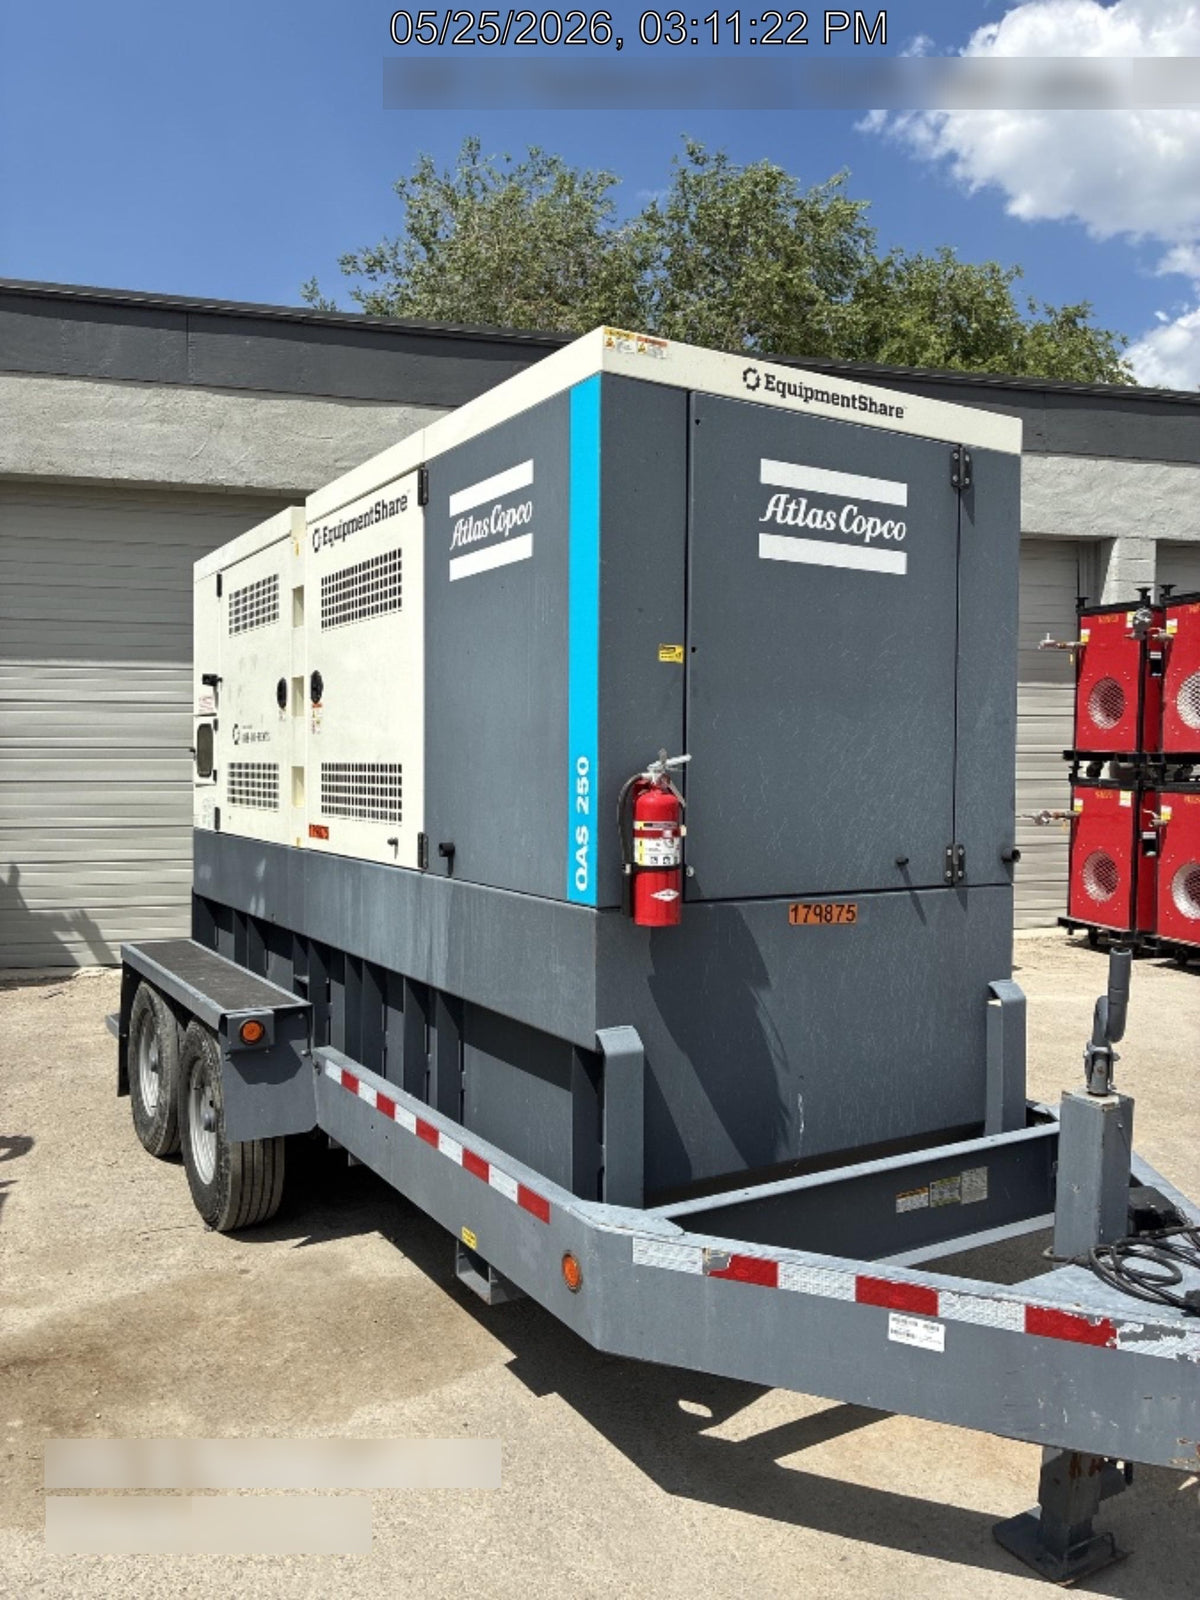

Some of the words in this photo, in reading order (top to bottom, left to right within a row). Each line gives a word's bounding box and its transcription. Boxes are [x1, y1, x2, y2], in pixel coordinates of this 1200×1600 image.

[764, 373, 905, 419] EquipmentShare
[323, 494, 408, 547] EquipmentShare
[576, 755, 590, 816] 250
[790, 903, 857, 924] 179875
